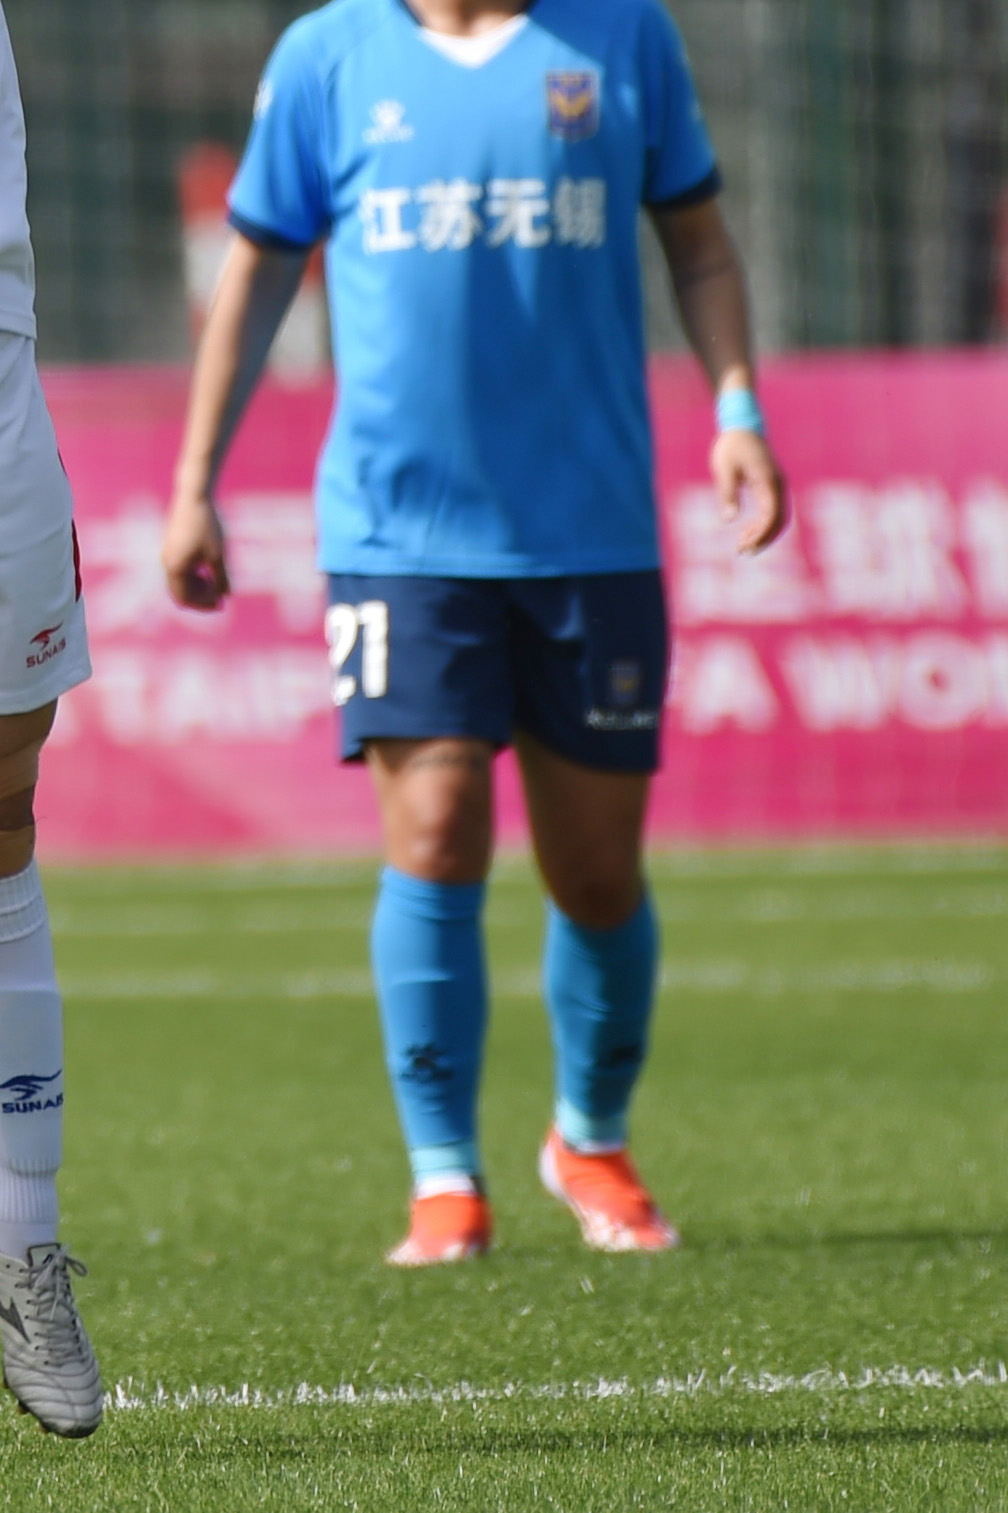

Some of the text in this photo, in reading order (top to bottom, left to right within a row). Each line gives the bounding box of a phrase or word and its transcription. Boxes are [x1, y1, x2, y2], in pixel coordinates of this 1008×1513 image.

[359, 177, 605, 255] 江苏无锡
[325, 600, 389, 707] 21
